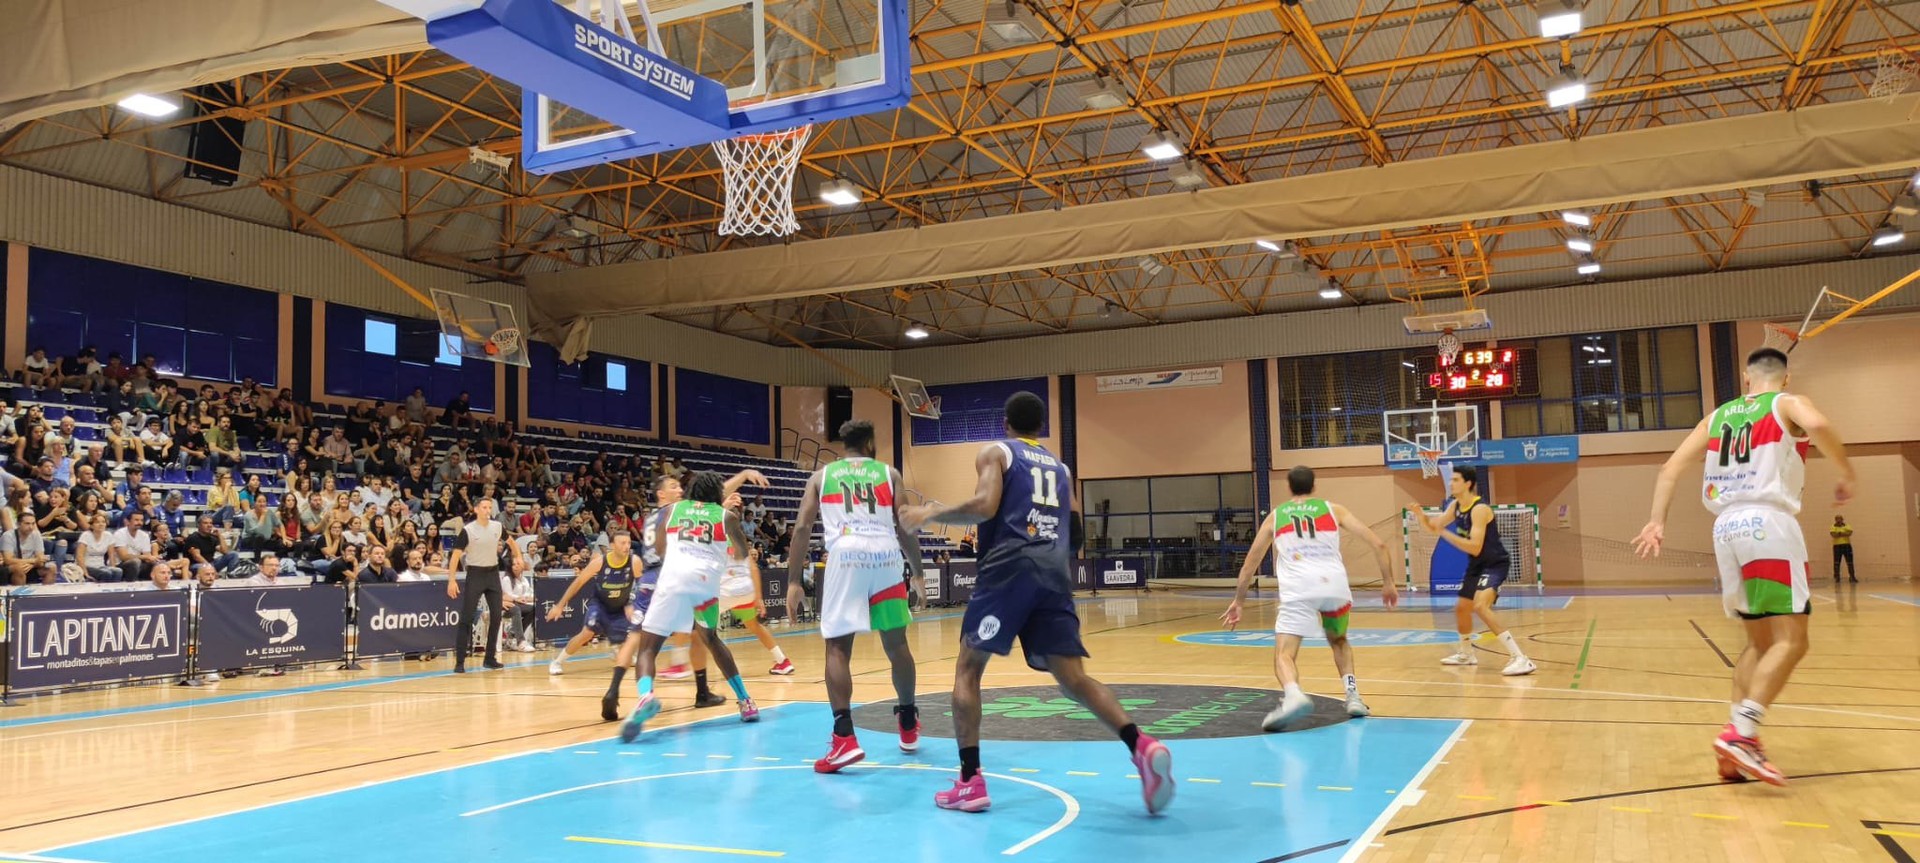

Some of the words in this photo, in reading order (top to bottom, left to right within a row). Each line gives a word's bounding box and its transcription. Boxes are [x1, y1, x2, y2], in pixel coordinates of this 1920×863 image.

[575, 23, 632, 66] SPORT
[632, 53, 695, 95] SYSTEM
[1503, 351, 1512, 362] 2
[1450, 376, 1467, 389] 30
[1471, 369, 1480, 380] 2
[1486, 374, 1503, 387] 28
[1718, 420, 1752, 467] 10
[838, 480, 877, 514] 14
[1030, 466, 1060, 508] 11
[677, 518, 713, 545] 23
[1289, 514, 1316, 539] 11
[370, 606, 460, 631] damex.io
[27, 613, 170, 659] LAPITANZA
[246, 648, 259, 656] LA
[261, 645, 306, 655] ESQUINA
